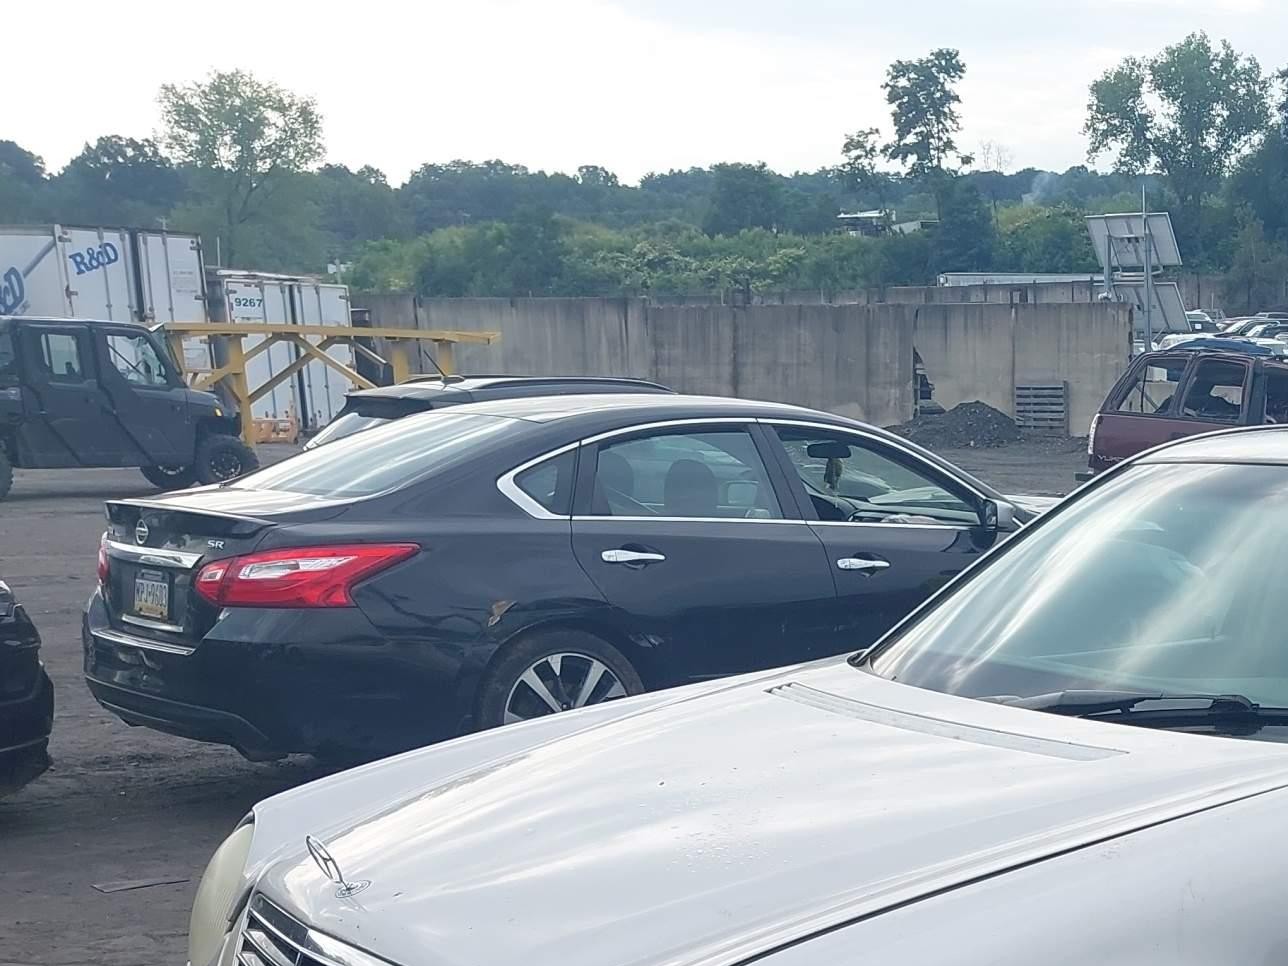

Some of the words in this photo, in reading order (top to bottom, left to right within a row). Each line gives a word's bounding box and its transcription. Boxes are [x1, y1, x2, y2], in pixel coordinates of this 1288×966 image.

[69, 242, 119, 275] R&D
[234, 297, 262, 308] 9267
[207, 539, 225, 550] SR
